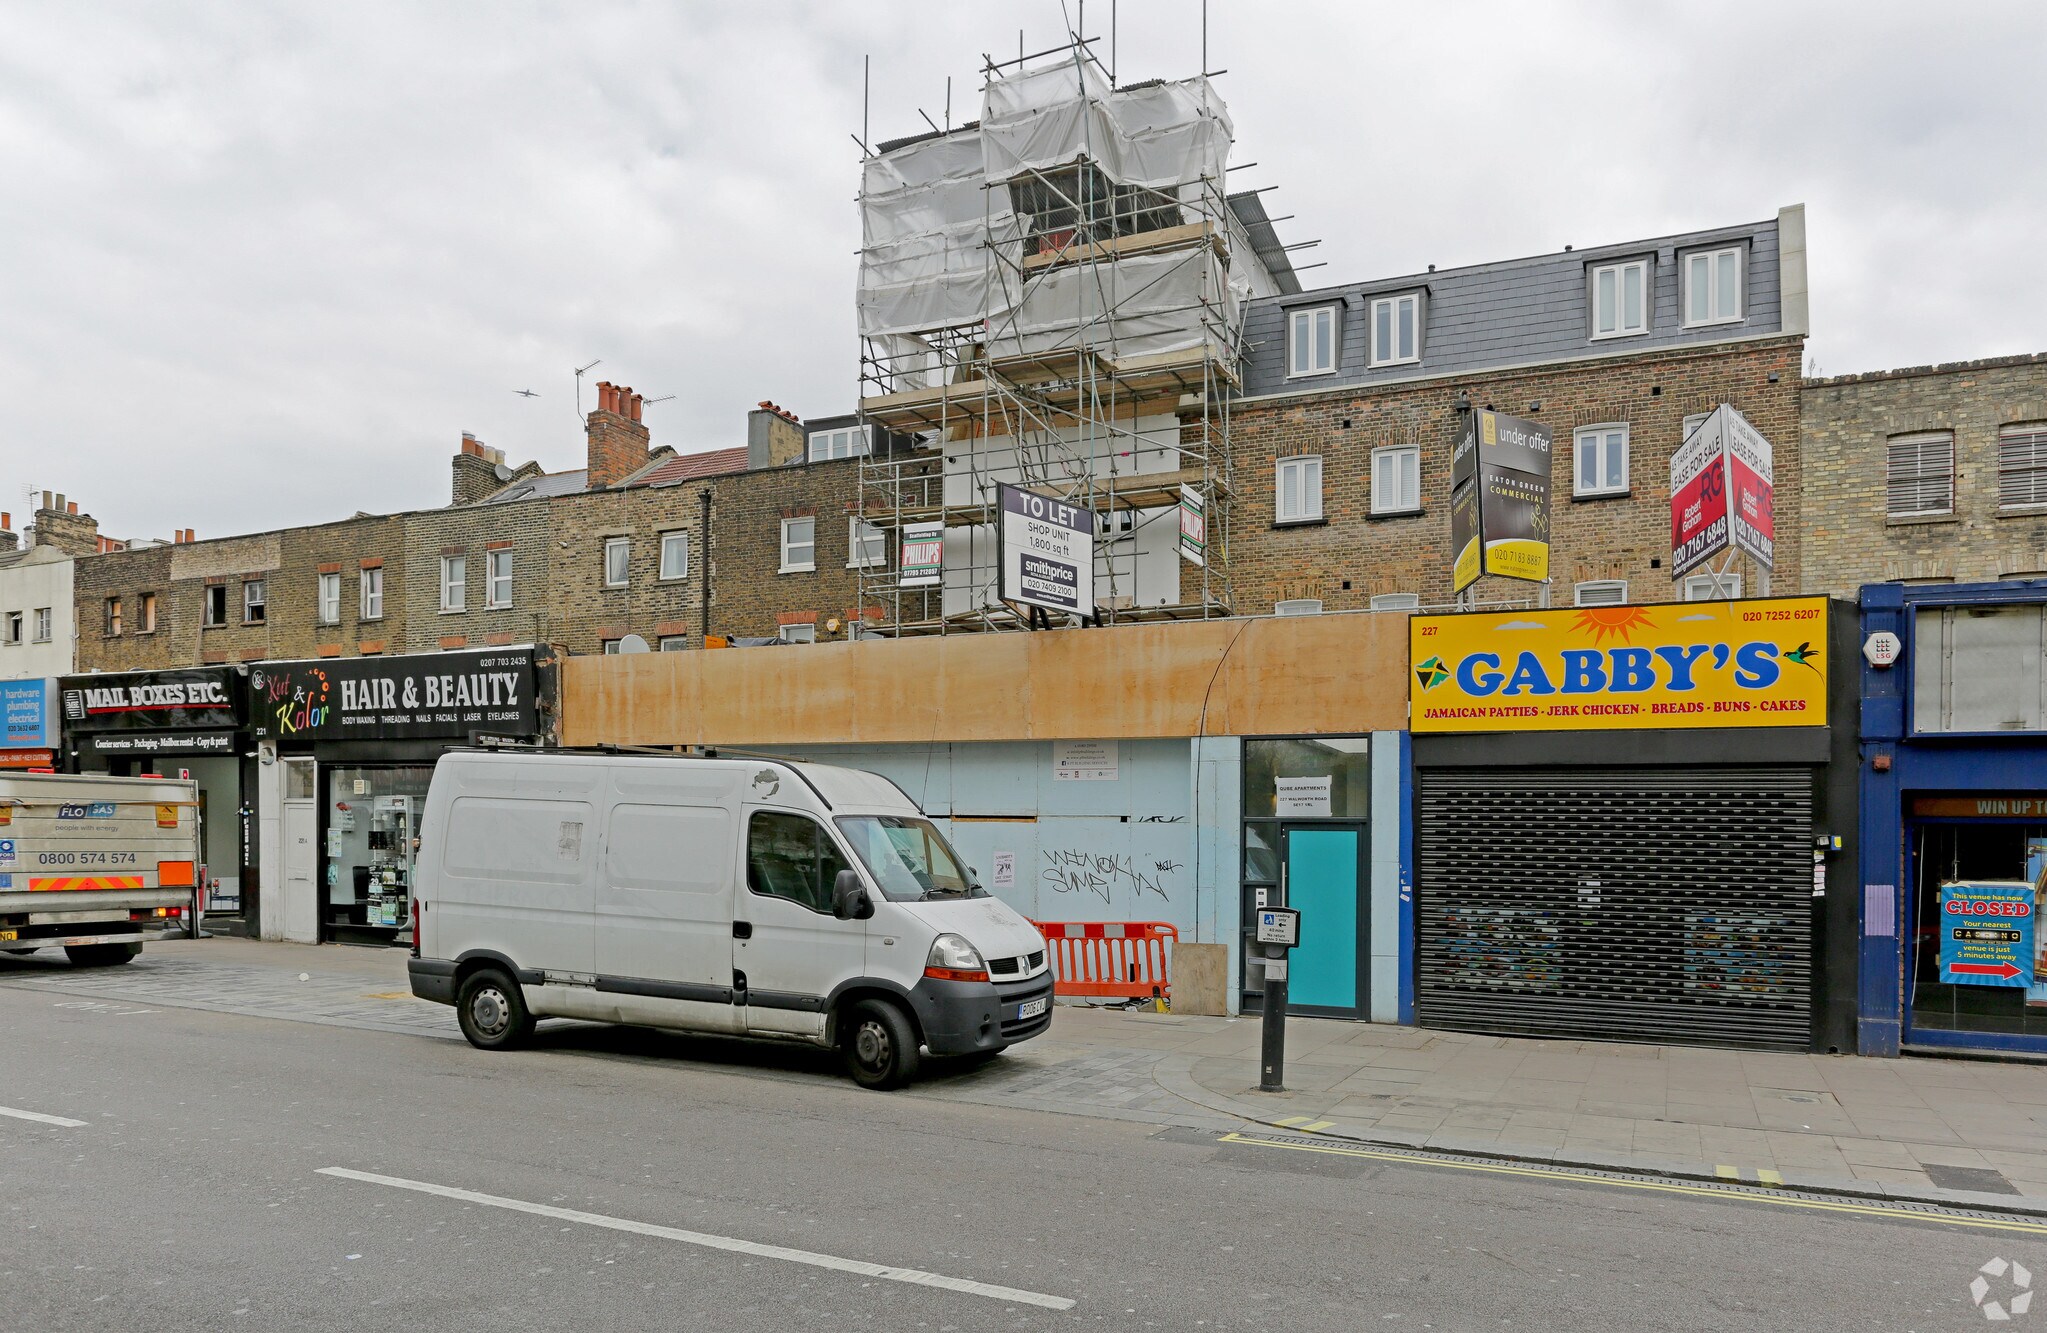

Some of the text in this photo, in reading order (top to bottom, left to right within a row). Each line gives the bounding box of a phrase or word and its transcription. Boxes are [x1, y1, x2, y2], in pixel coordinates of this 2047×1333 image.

[1500, 428, 1526, 446] under
[1529, 432, 1550, 452] offer
[1672, 436, 1720, 492] LEASE FOR SALE
[1748, 449, 1758, 470] FOR
[1490, 474, 1544, 492] EATON GREEN
[1490, 486, 1544, 503] COMMERCIAL
[1020, 492, 1077, 527] TO LET
[1684, 498, 1701, 520] Robert
[1682, 512, 1702, 532] Graham
[1028, 522, 1070, 542] SHOP UNIT
[1673, 544, 1686, 566] 020
[1687, 530, 1705, 558] 7167
[1706, 516, 1726, 544] 6848
[904, 543, 939, 565] PHILLIPS
[1030, 536, 1070, 556] 1,800 sq ft
[1494, 549, 1508, 560] 020
[1510, 551, 1525, 563] 7183
[1026, 560, 1073, 581] smithprice
[1028, 579, 1072, 596] 020 7409 2100
[1743, 610, 1820, 622] 020 7252 6207
[1422, 627, 1438, 636] 227
[480, 657, 526, 667] 0207 703 2435
[1456, 641, 1781, 697] GABBY'S
[6, 689, 39, 698] hardware
[85, 682, 228, 708] MAIL BOXES ETC.
[294, 686, 305, 703] &
[340, 672, 519, 710] HAIR & BEAUTY
[7, 700, 39, 713] plumbing
[276, 692, 329, 734] Kolor
[1424, 700, 1806, 719] JAMAICAN PATTIES JERK CHICKEN BREADS BUNS CAKES
[8, 713, 39, 723] electrical
[356, 716, 375, 724] WAXING
[381, 715, 410, 724] THREADING
[416, 714, 431, 722] NAILS
[436, 713, 457, 722] FACIALS
[464, 713, 481, 722] LASER
[488, 712, 519, 721] EYELASHES
[95, 737, 228, 750] Courier services Packaging Mailbox rental Copy & print
[61, 804, 113, 817] FLO GAS
[1976, 801, 2008, 814] WIN
[2011, 801, 2031, 814] UP
[39, 853, 136, 864] 0800 574 574
[1945, 900, 2030, 917] CLOSED
